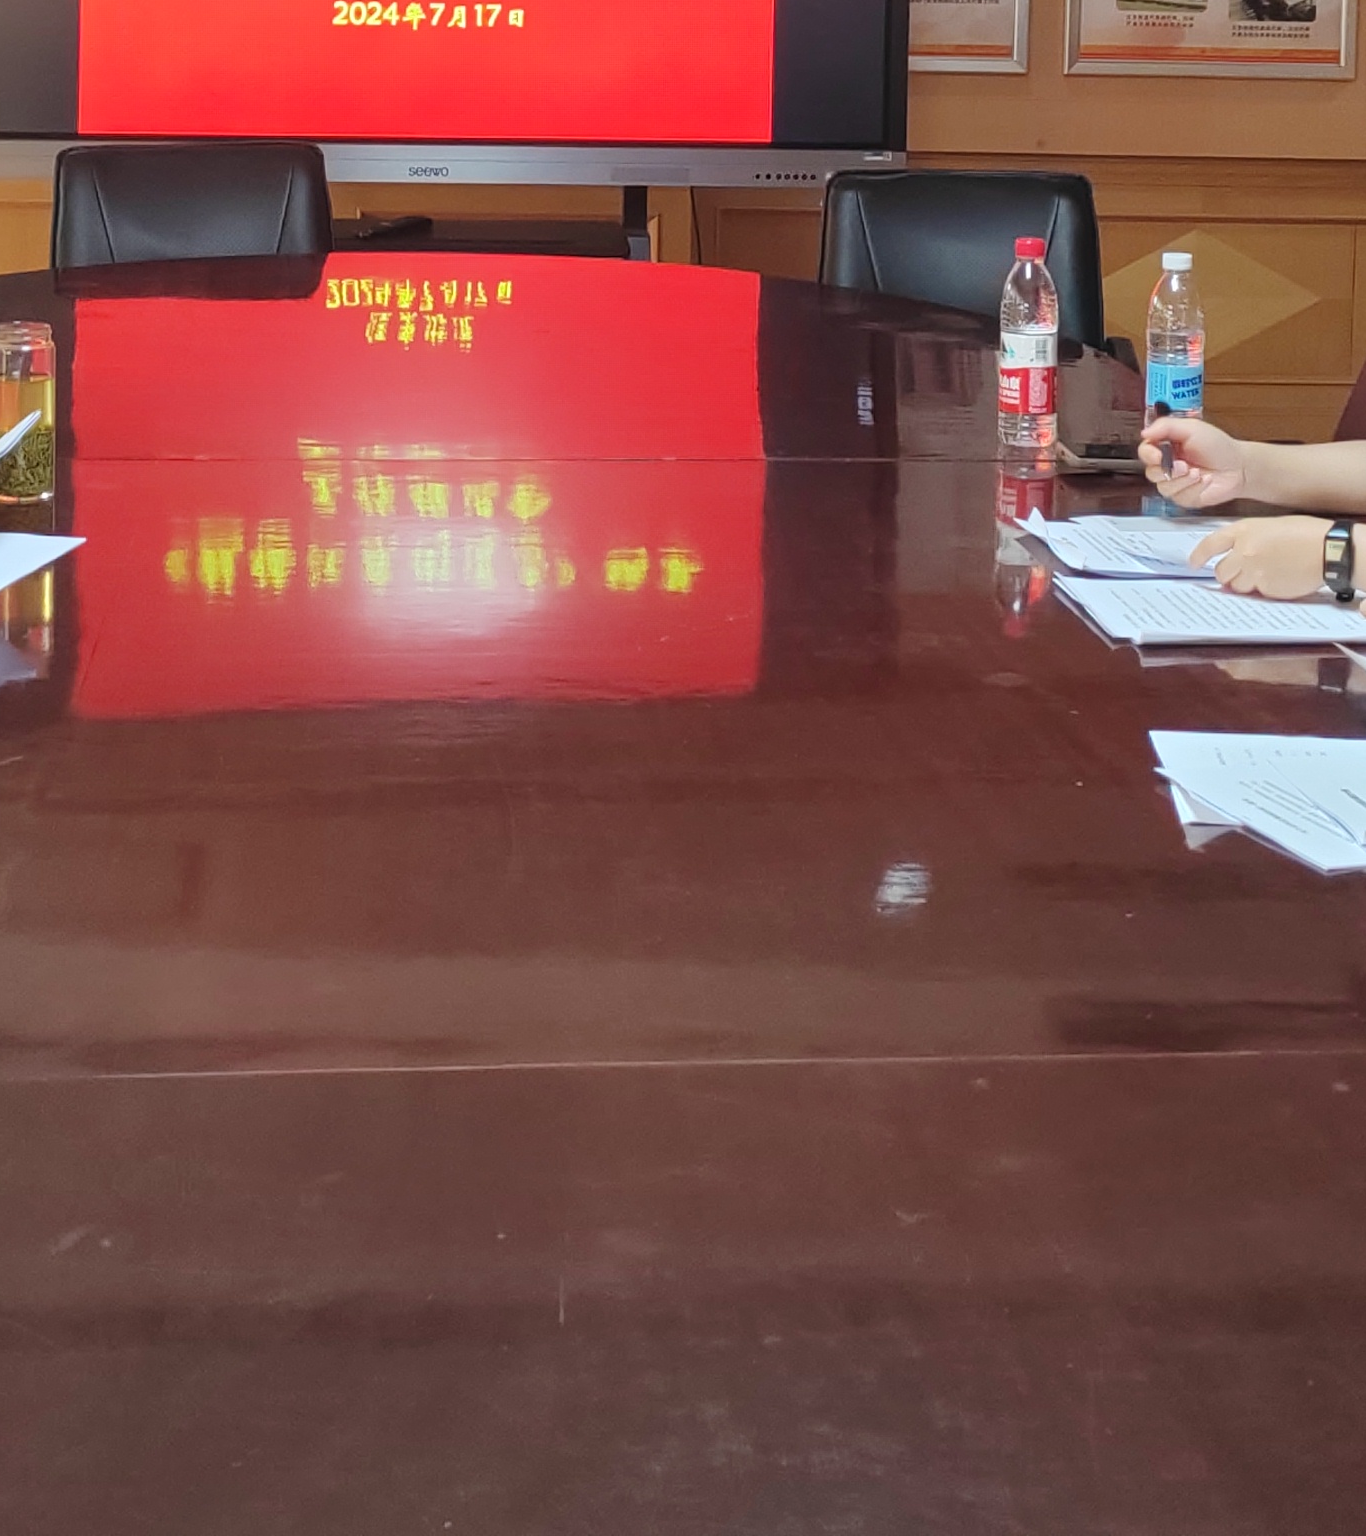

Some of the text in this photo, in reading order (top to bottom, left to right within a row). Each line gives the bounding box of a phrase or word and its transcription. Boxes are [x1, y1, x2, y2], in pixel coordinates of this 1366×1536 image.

[332, 2, 526, 32] 2024年7月17日
[408, 166, 449, 177] seewo
